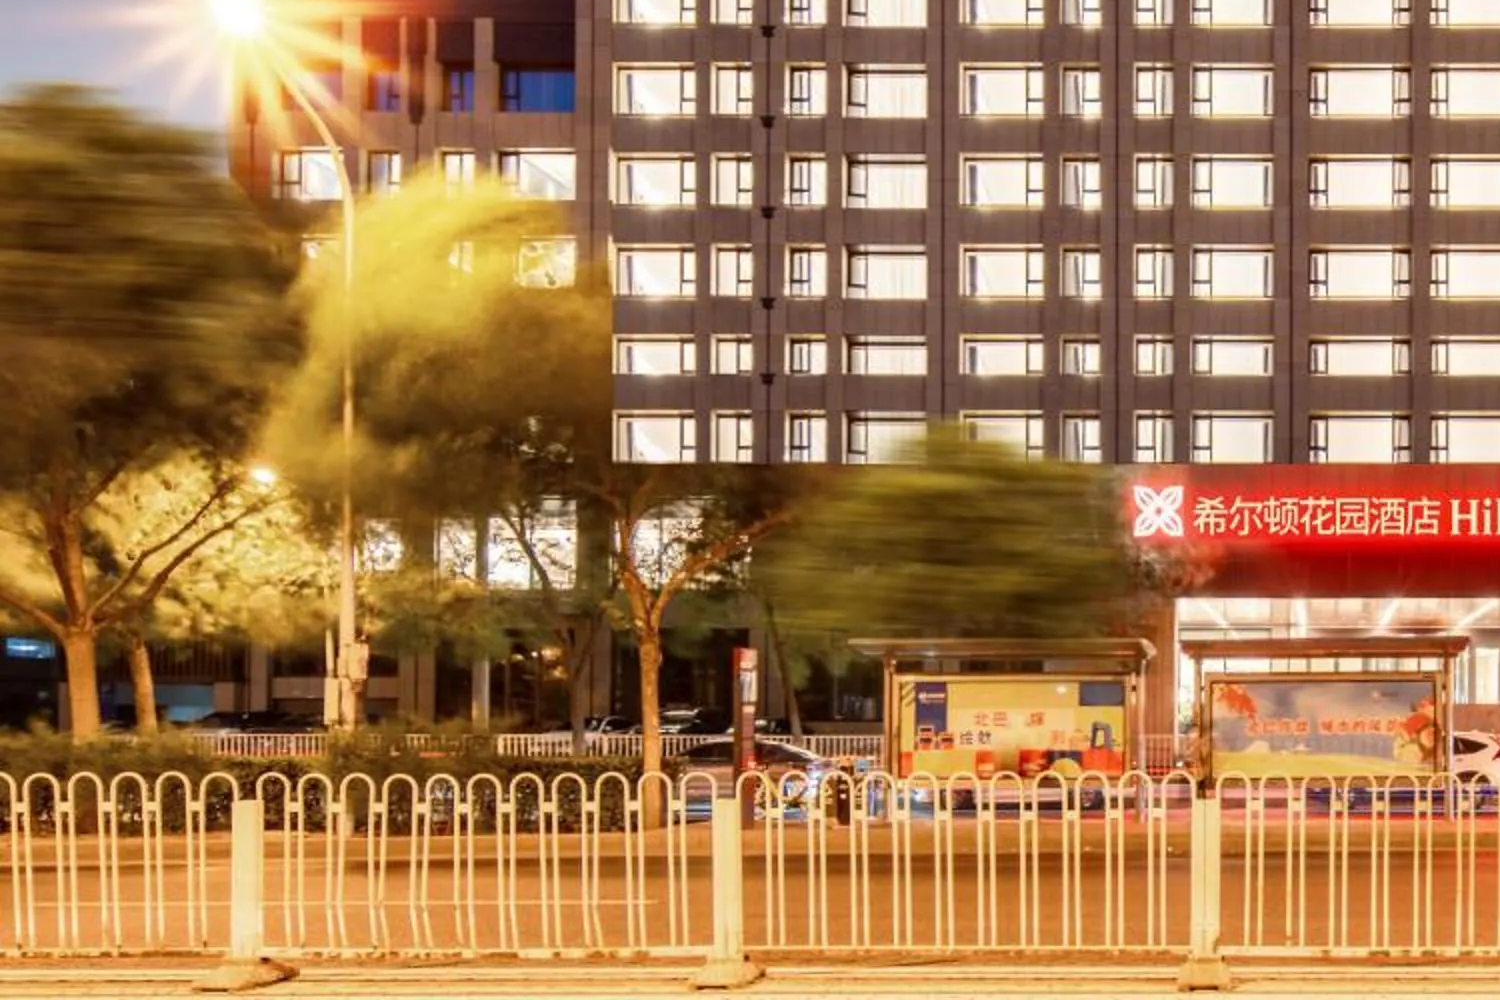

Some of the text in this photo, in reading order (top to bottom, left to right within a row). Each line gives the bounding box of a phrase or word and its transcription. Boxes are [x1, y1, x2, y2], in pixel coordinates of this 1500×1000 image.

[1193, 496, 1440, 537] 希尔顿花园酒店
